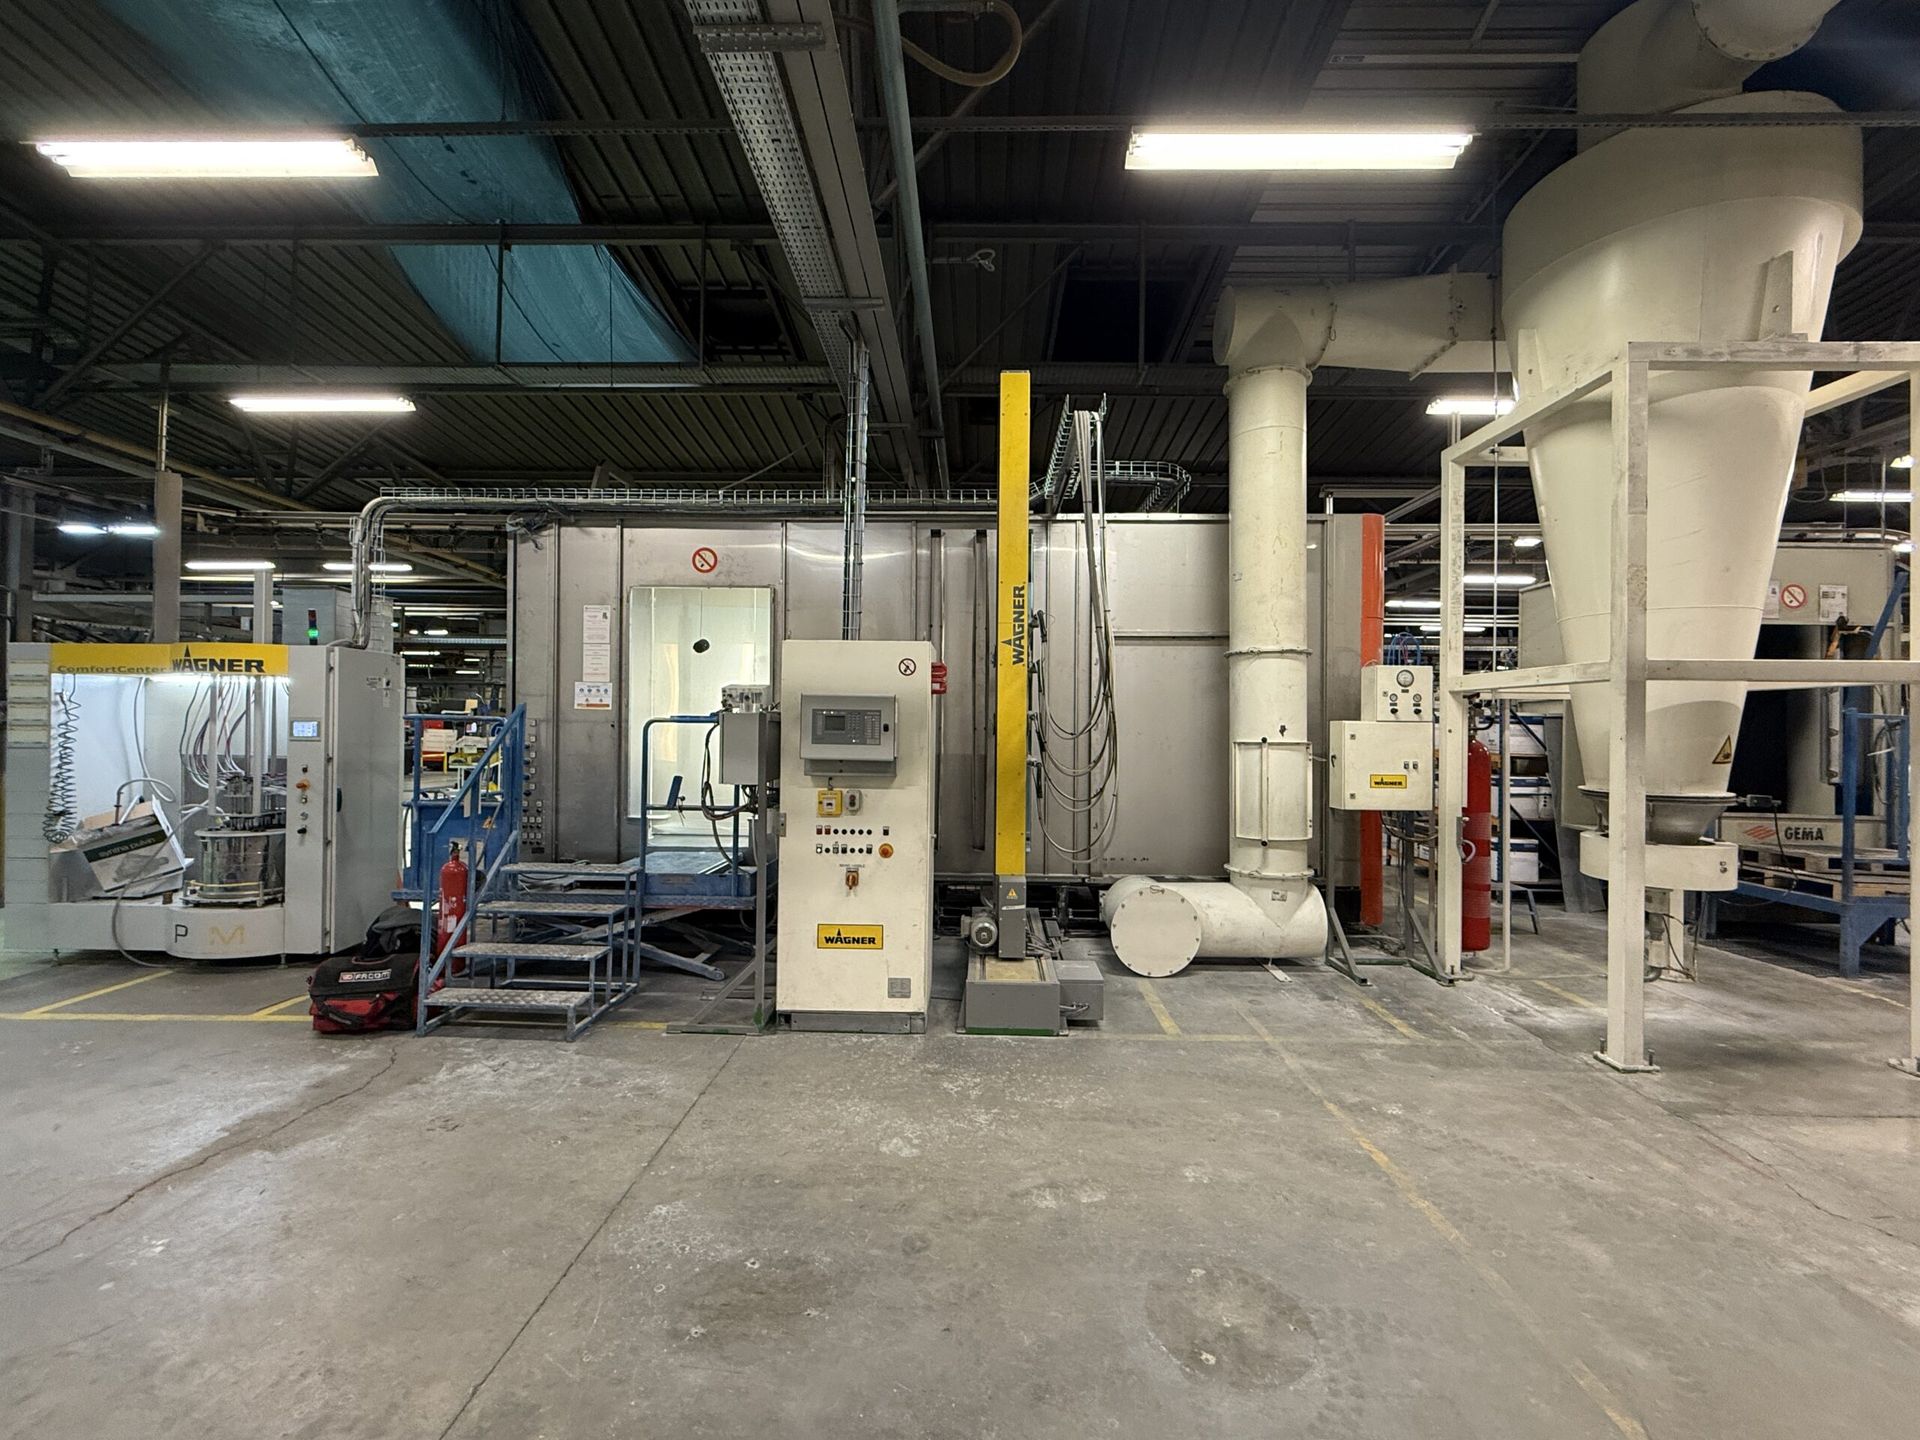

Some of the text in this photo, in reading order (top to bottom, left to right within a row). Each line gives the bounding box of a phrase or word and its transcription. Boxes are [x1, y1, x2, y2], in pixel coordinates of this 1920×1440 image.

[57, 665, 165, 674] ComfortCenter
[1784, 826, 1824, 841] GEMA
[174, 924, 188, 943] P
